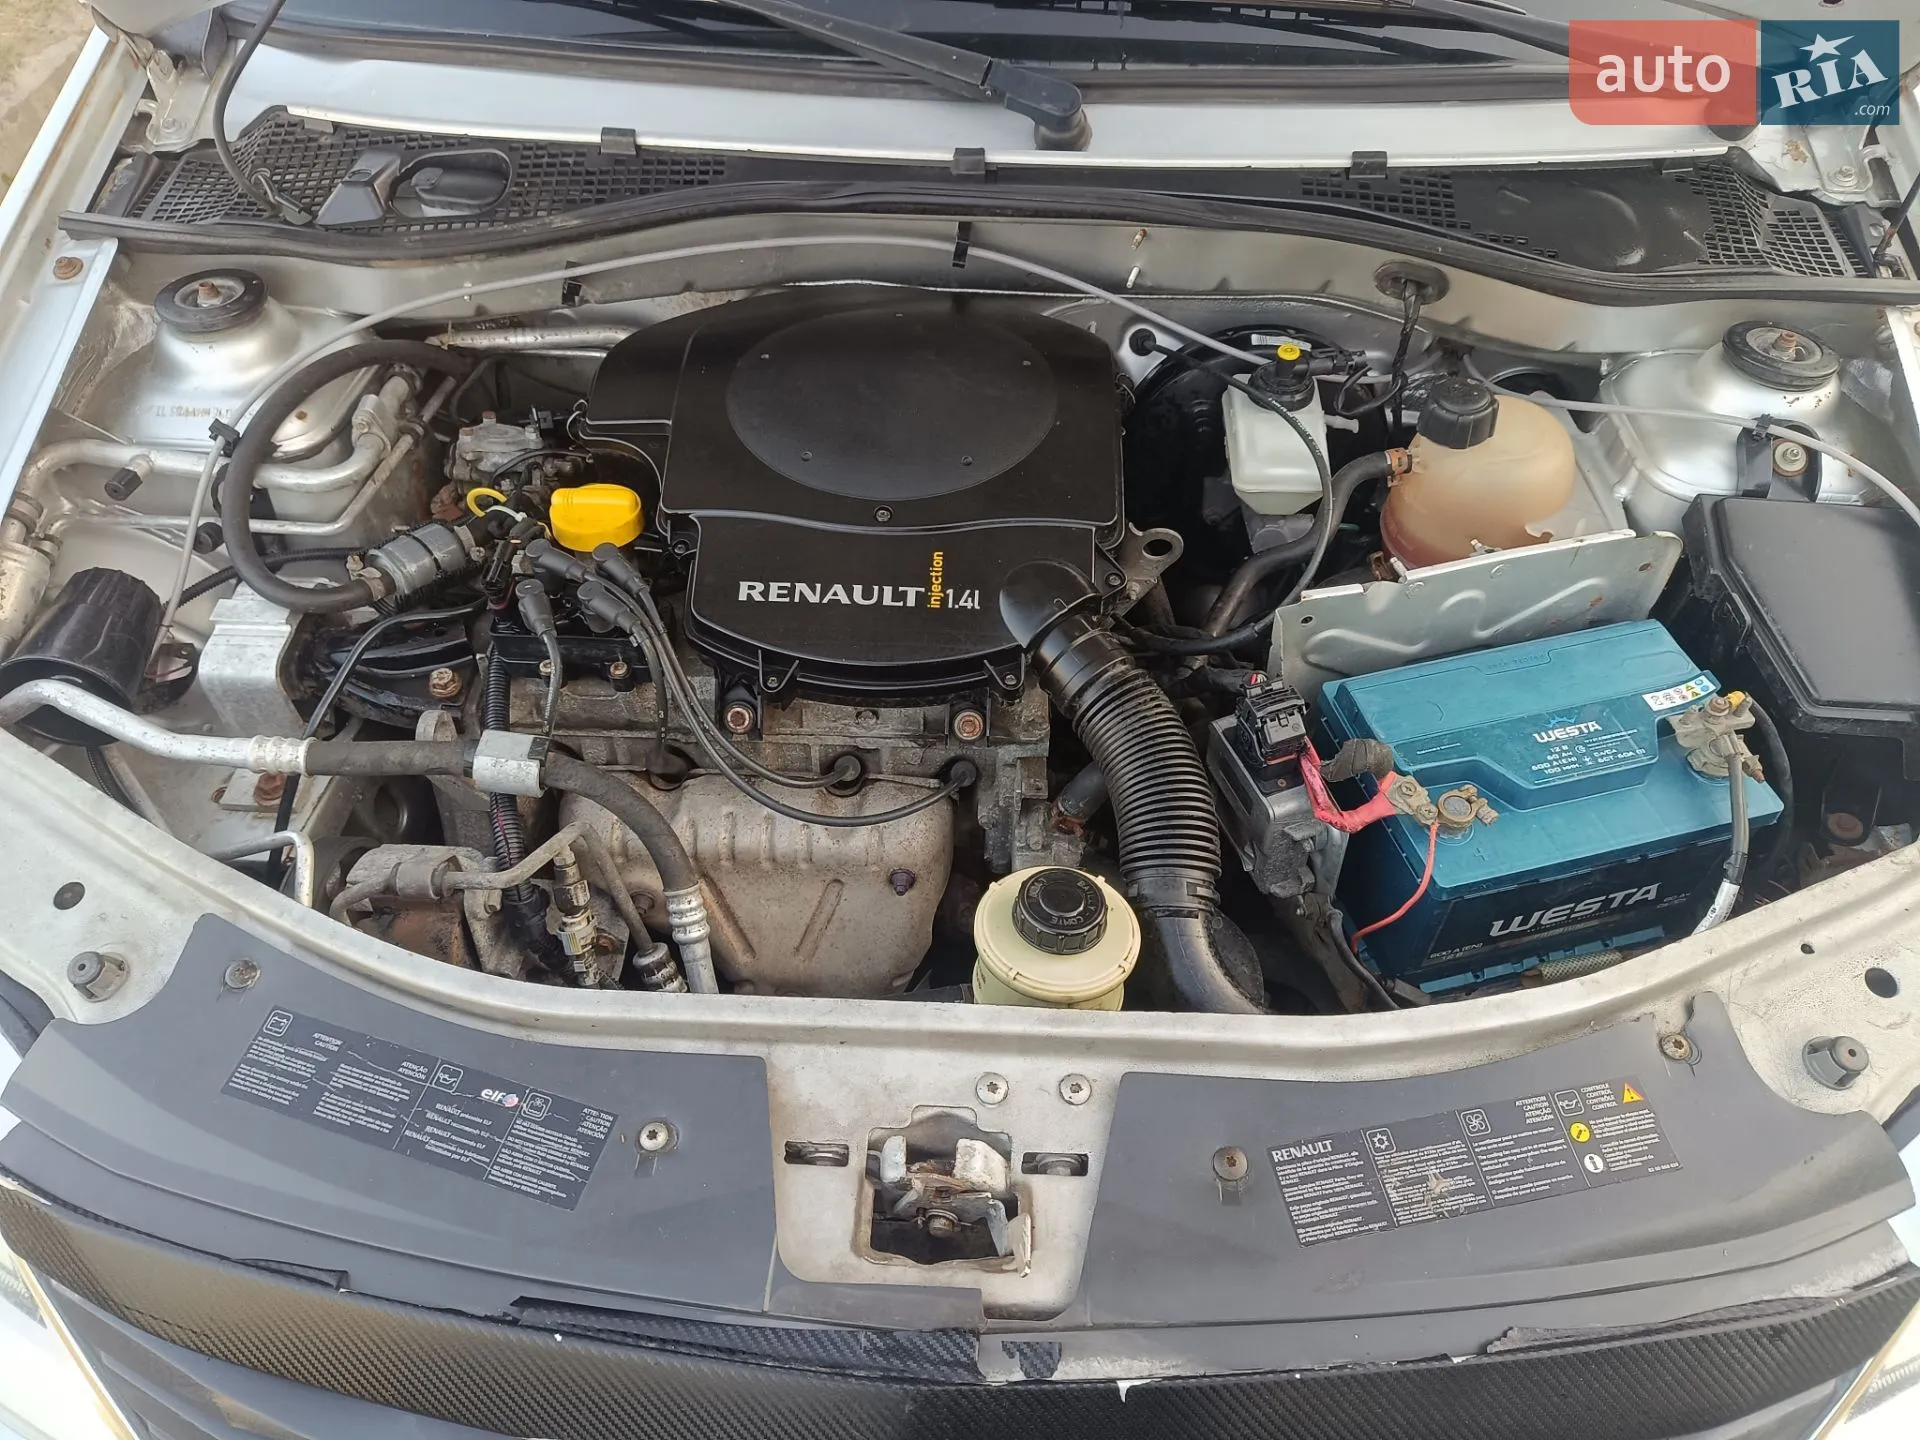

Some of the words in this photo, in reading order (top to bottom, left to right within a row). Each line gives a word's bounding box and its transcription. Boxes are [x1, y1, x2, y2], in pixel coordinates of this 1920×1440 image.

[927, 551, 944, 609] injection
[738, 581, 925, 607] RENAULT
[1532, 721, 1602, 743] WESTA
[1544, 766, 1562, 775] 100
[1490, 882, 1663, 937] WESTA
[314, 1040, 339, 1051] CAUTION
[480, 1087, 506, 1103] elf
[1586, 1089, 1613, 1098] CONTROL
[436, 1104, 461, 1116] RENAULT
[1523, 1102, 1549, 1111] CAUTION
[1524, 1108, 1552, 1117] ATENÇÃO
[425, 1113, 452, 1125] RENAULT
[586, 1116, 611, 1127] CAUTION
[425, 1126, 451, 1138] RENAULT
[581, 1121, 608, 1133] ATENÇÃO
[404, 1130, 431, 1142] RENAULT
[1272, 1140, 1335, 1162] RENAULT
